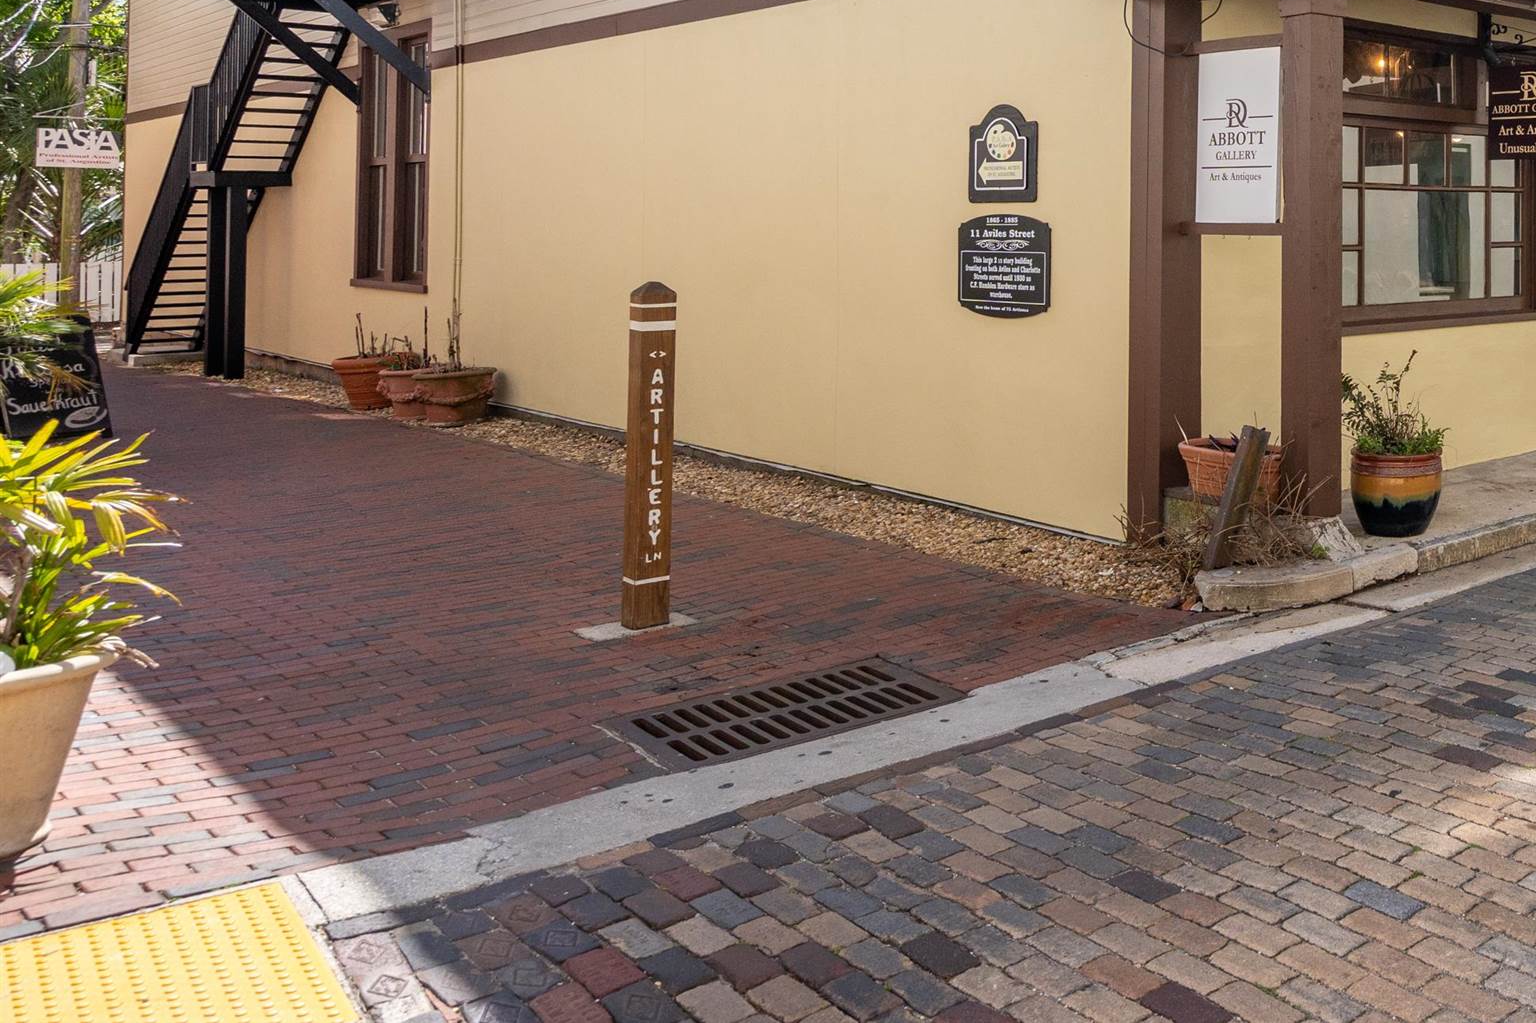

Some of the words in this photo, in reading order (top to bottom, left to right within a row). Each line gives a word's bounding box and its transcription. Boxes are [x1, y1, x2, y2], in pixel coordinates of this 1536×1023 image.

[1491, 103, 1530, 115] ABBOTT
[1498, 125, 1514, 136] Art
[1515, 124, 1525, 136] &
[1208, 130, 1266, 146] ABBOTT
[1215, 150, 1257, 161] GALLERY
[1209, 172, 1220, 182] Art
[1221, 172, 1229, 181] &
[1230, 171, 1262, 183] Antiques
[970, 229, 980, 238] 11
[982, 229, 1007, 238] Aviles
[1009, 229, 1035, 238] Street
[6, 388, 99, 416] Sauekraut
[648, 367, 665, 546] ARTILLERY
[645, 551, 662, 563] LN
